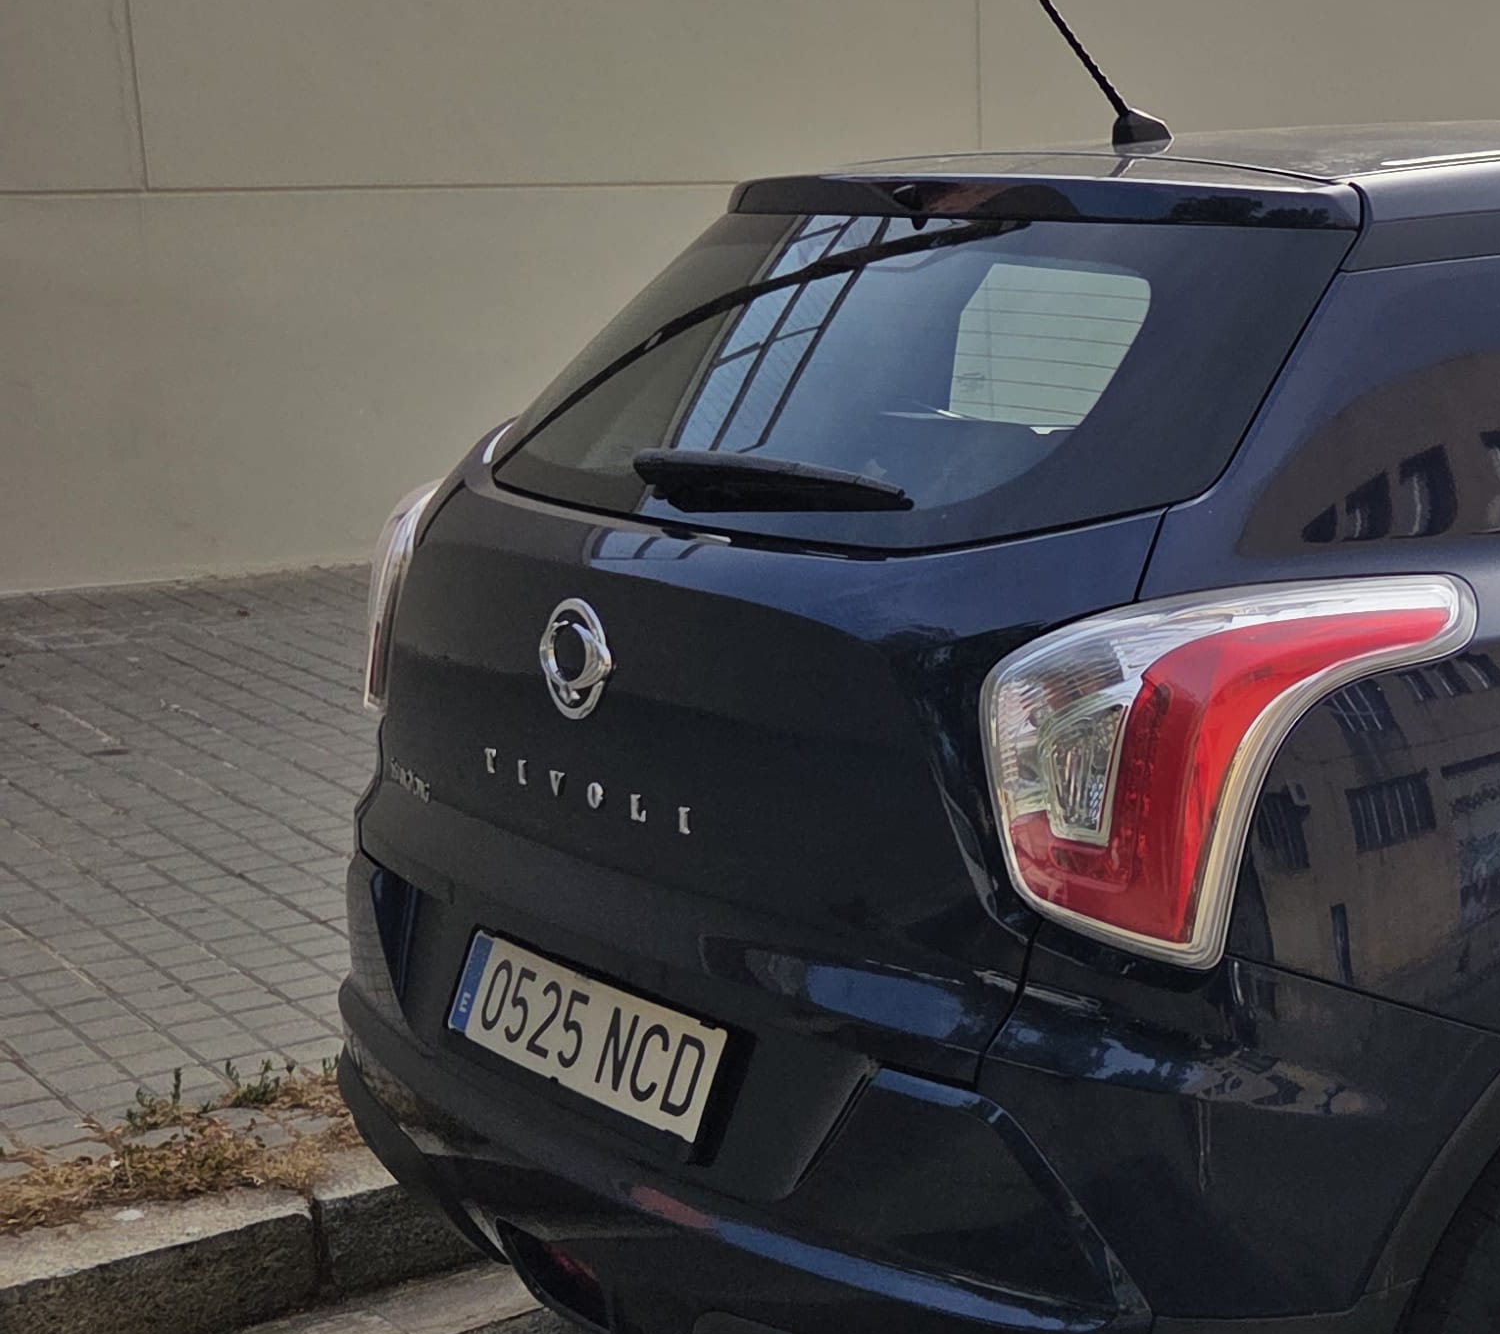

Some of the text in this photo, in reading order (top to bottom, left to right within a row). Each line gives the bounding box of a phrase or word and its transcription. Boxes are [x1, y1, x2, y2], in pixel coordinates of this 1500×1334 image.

[484, 747, 690, 835] TIVOLI
[459, 991, 471, 1013] E
[481, 959, 705, 1117] 0525 NCD
